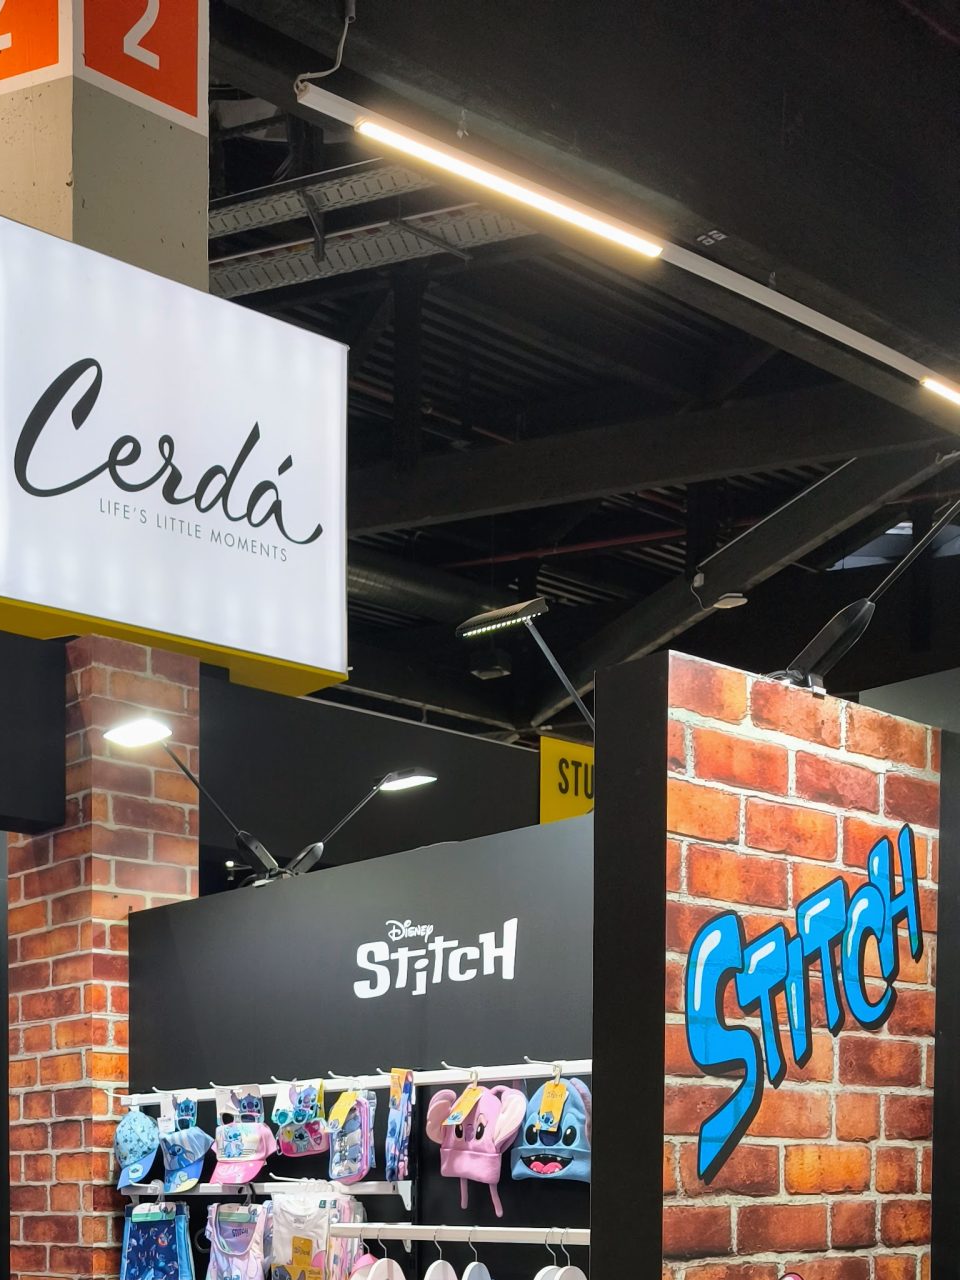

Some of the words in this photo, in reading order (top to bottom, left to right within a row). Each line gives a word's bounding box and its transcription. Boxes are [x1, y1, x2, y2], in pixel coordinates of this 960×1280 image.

[123, 0, 160, 70] 2
[14, 358, 323, 545] Cerdá
[99, 498, 147, 524] LIFE'S
[157, 513, 201, 539] LITTLE
[210, 529, 287, 562] MOMENTS
[685, 823, 924, 1185] STITCH
